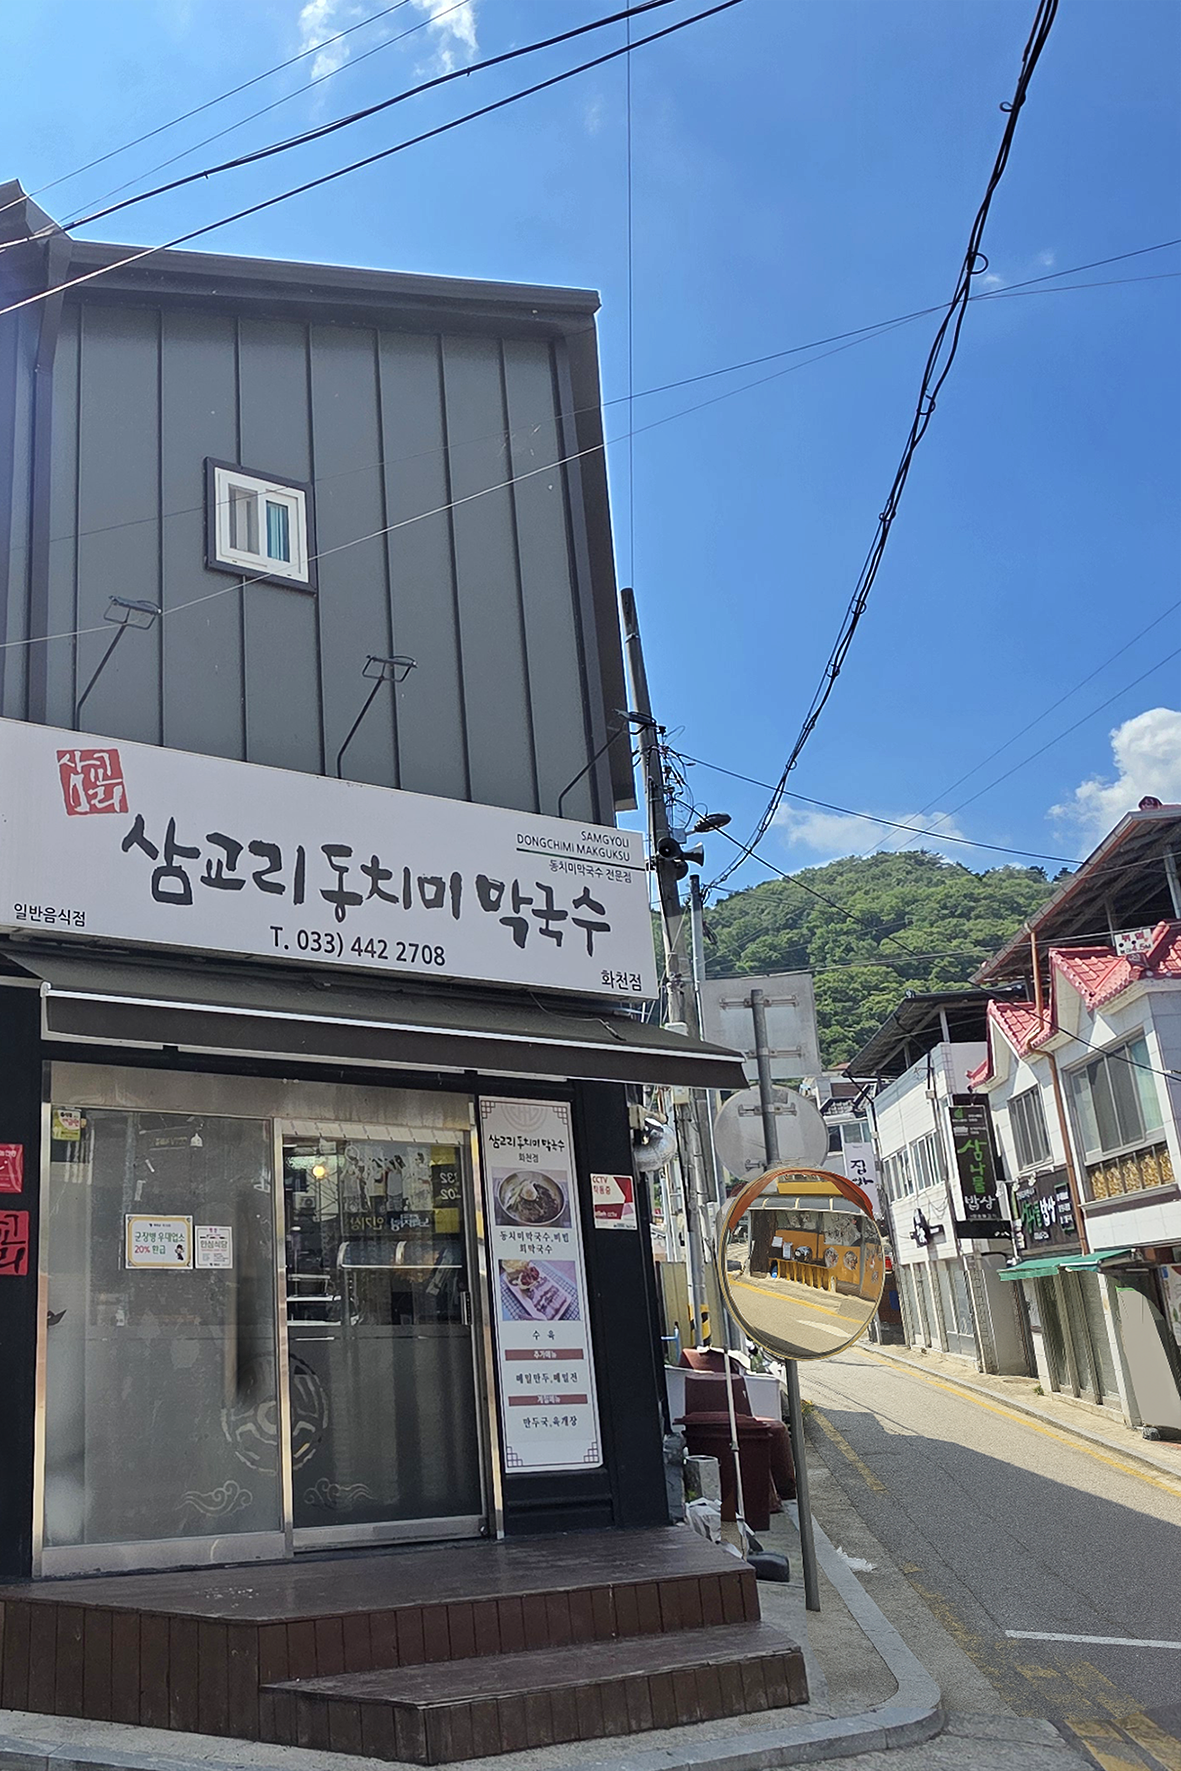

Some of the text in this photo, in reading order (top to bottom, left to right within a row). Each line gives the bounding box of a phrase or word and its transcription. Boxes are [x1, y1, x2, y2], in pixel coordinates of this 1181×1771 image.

[516, 833, 631, 862] DONGCHIMI MAKGUKSU
[549, 859, 632, 884] 동치미막국수 전문점
[120, 813, 612, 958] 삼교리 동치미 막국수
[12, 902, 87, 929] 일반음식점
[296, 929, 345, 960] 033)
[350, 937, 390, 961] 442
[395, 942, 447, 967] 2708
[600, 969, 643, 992] 화천점
[592, 1175, 609, 1184] CCTV
[134, 1245, 150, 1254] 20%
